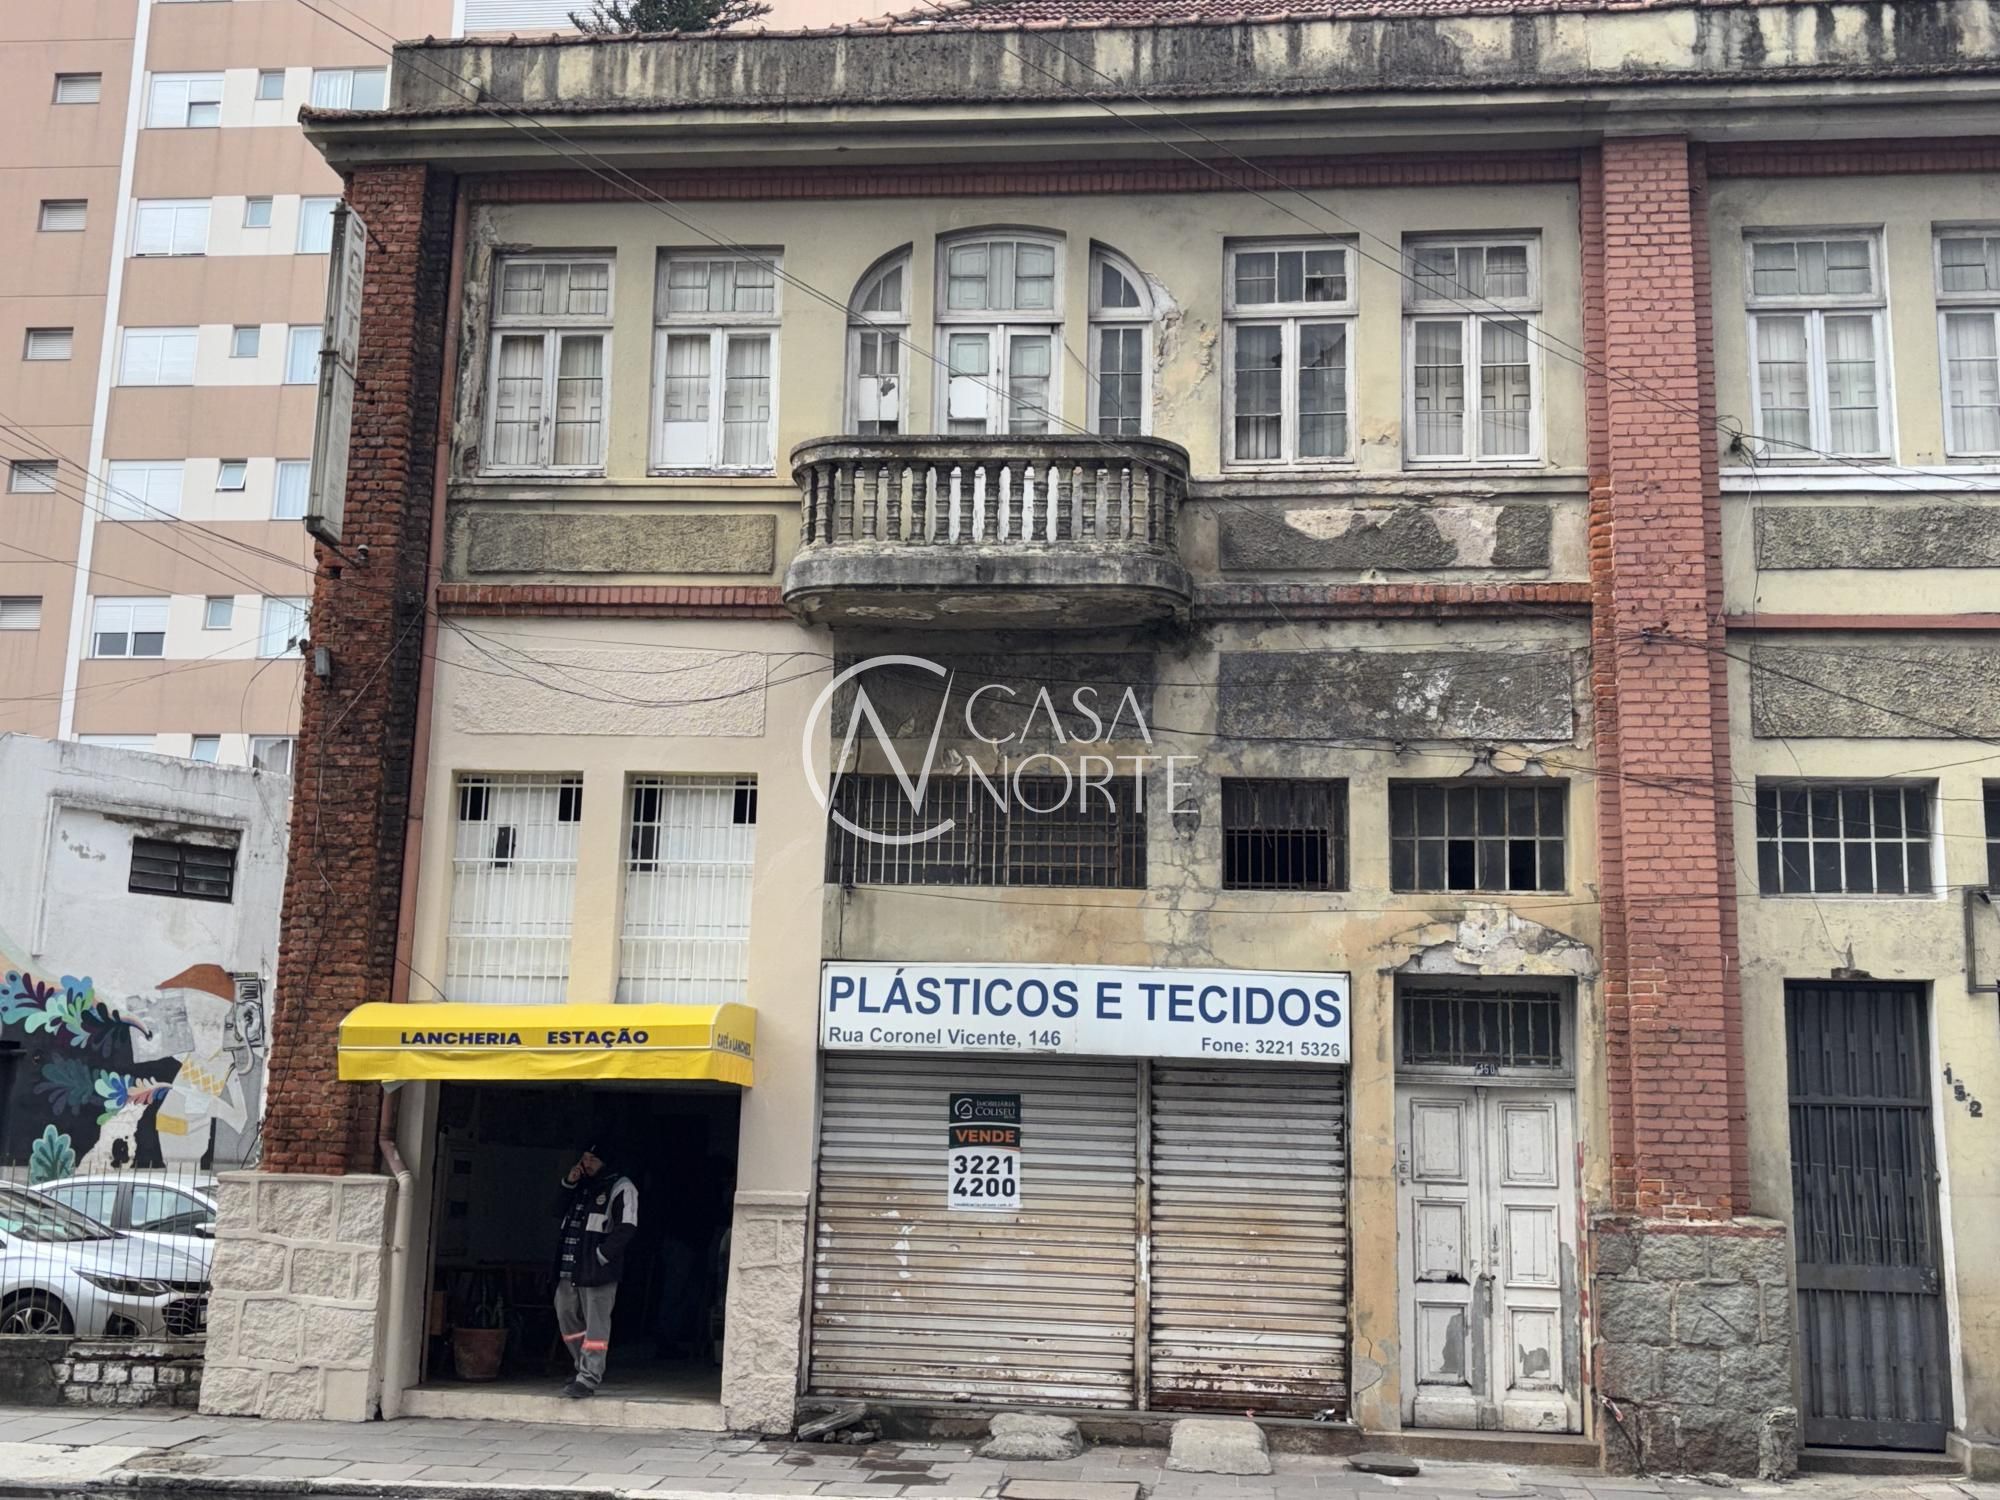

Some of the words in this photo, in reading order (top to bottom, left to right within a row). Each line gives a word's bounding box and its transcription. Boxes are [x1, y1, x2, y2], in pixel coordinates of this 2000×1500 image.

[828, 968, 1079, 1019] PLÁSTICOS
[1096, 981, 1123, 1020] E
[1138, 982, 1342, 1028] TECIDOS
[400, 1031, 522, 1046] LANCHERIA
[547, 1028, 649, 1048] ESTAÇÃO
[828, 1026, 864, 1043] Rua
[869, 1026, 942, 1045] Coronel
[947, 1028, 1022, 1048] Vicente,
[1028, 1030, 1062, 1046] 146
[1201, 1037, 1250, 1054] Fone:
[1255, 1039, 1294, 1056] 3221
[1300, 1041, 1341, 1057] 5326
[975, 1106, 1016, 1116] COLISEU
[955, 1129, 1016, 1143] VENDE
[954, 1155, 1013, 1175] 3221
[953, 1177, 1016, 1197] 4200
